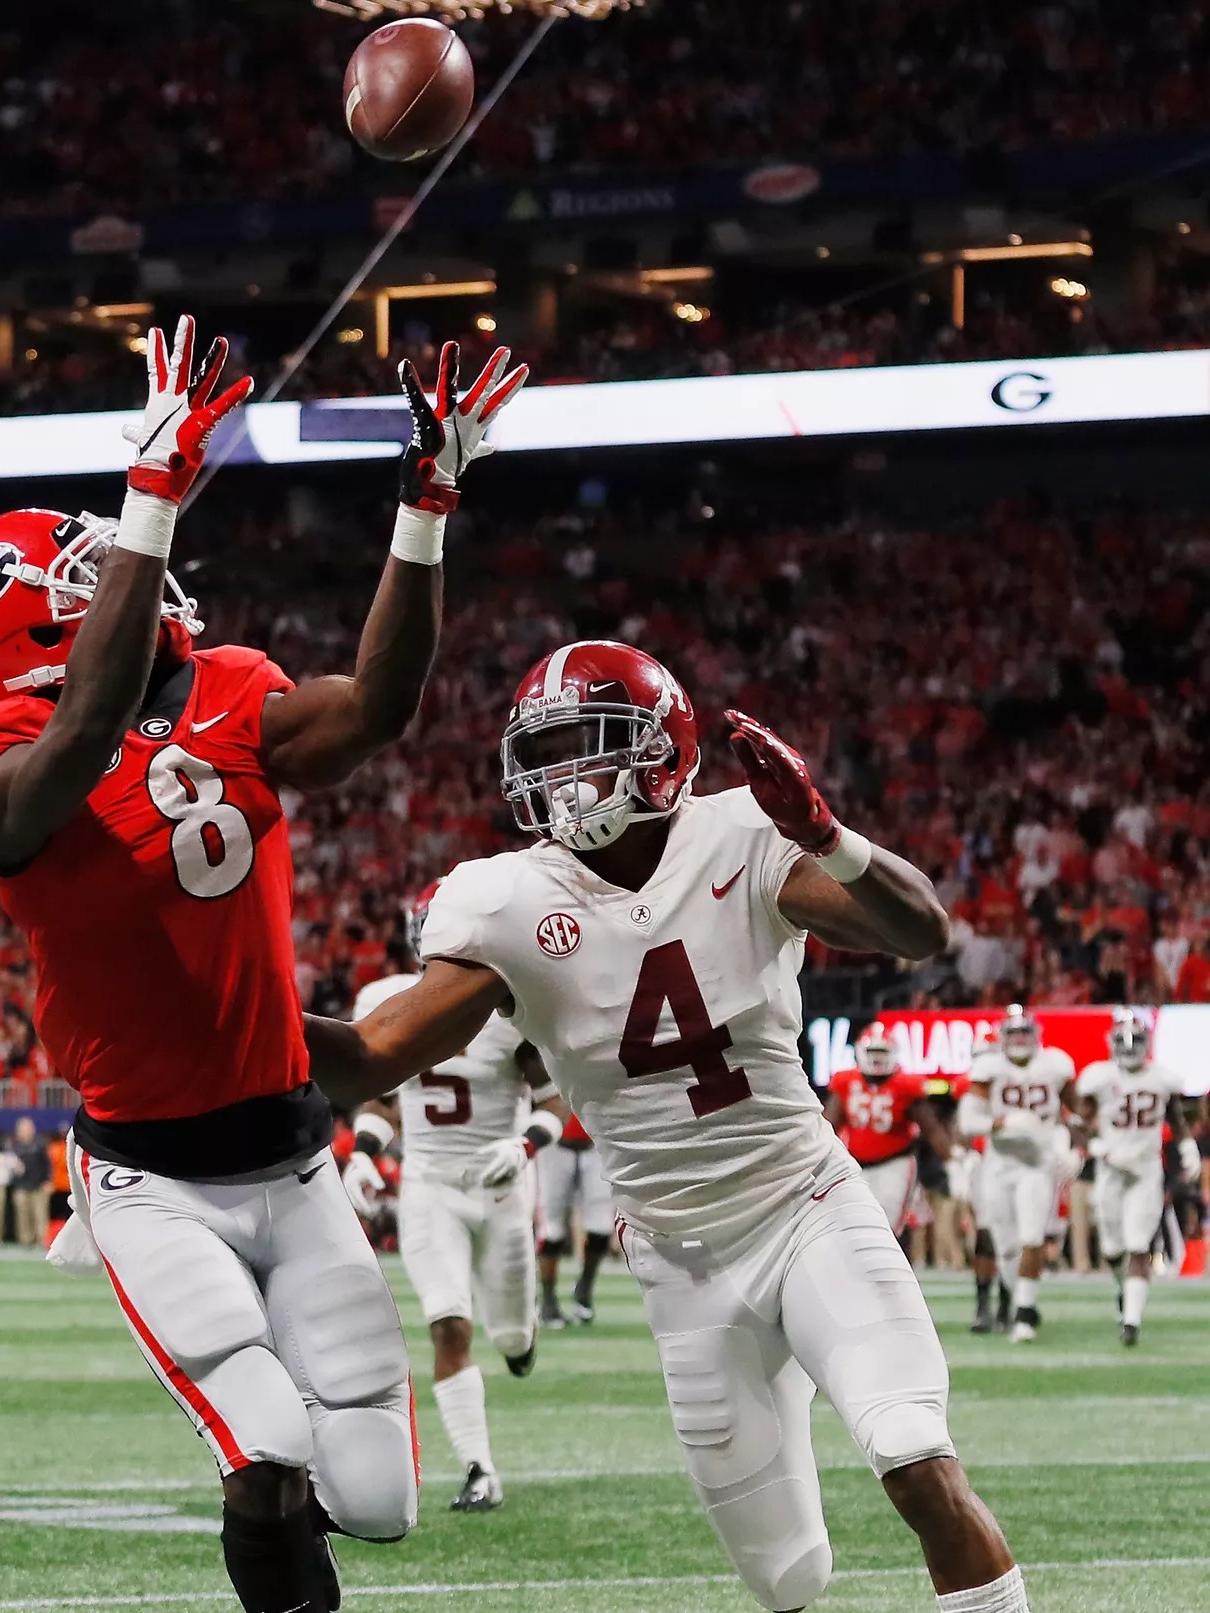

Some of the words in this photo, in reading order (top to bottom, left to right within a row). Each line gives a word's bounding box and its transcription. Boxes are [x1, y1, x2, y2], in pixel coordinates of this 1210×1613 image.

[991, 371, 1052, 413] G
[539, 695, 563, 708] BAMA
[140, 718, 172, 738] G
[147, 744, 254, 898] 8
[539, 914, 579, 956] SEC
[618, 938, 753, 1119] 4
[890, 1020, 974, 1074] ALAB
[419, 1050, 473, 1126] 5
[847, 1090, 894, 1134] 55
[1111, 1091, 1157, 1128] 32
[100, 1167, 145, 1191] G
